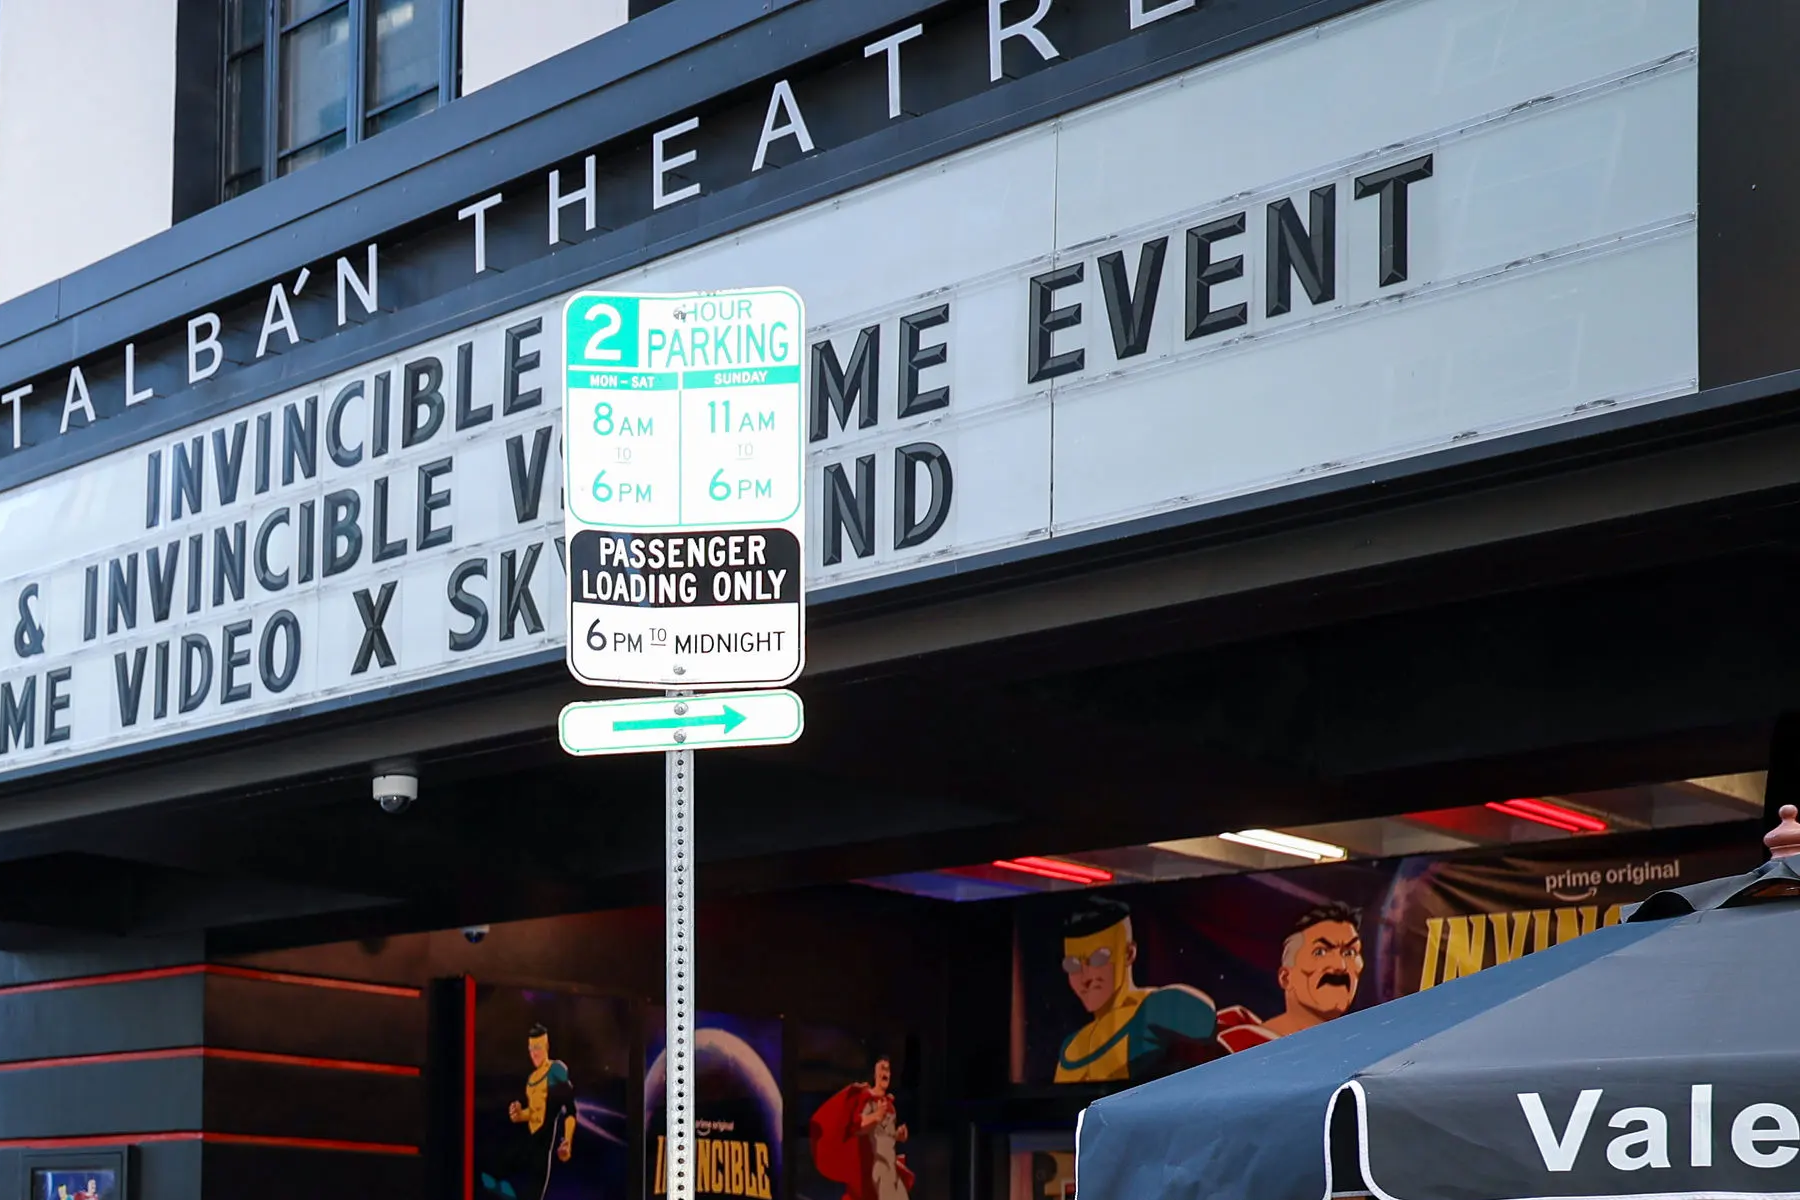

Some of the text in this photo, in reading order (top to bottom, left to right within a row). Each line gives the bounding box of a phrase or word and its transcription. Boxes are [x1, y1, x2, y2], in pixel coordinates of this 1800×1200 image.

[584, 299, 753, 361] 2 HOUR
[647, 321, 790, 369] PARKING
[589, 374, 618, 388] MON
[631, 375, 655, 389] SAT
[713, 370, 768, 386] SUNDAY
[13, 583, 45, 659] &
[83, 456, 454, 643] INVINCIBLE
[1027, 152, 1434, 385] EVENT
[146, 316, 543, 530] INVINCIBLE
[593, 402, 654, 437] 8 AM
[707, 400, 776, 434] 11 AM
[592, 469, 652, 503] 6 PM
[708, 468, 773, 501] 6 PM
[599, 534, 767, 569] PASSENGER
[582, 569, 788, 604] LOADING ONLY
[586, 618, 608, 652] 6
[613, 632, 643, 653] PM
[675, 631, 786, 655] MIDNIGHT
[113, 609, 304, 730] VIDEO
[349, 579, 399, 677] X
[1545, 860, 1681, 893] prime original
[654, 1135, 773, 1200] INCIBLE
